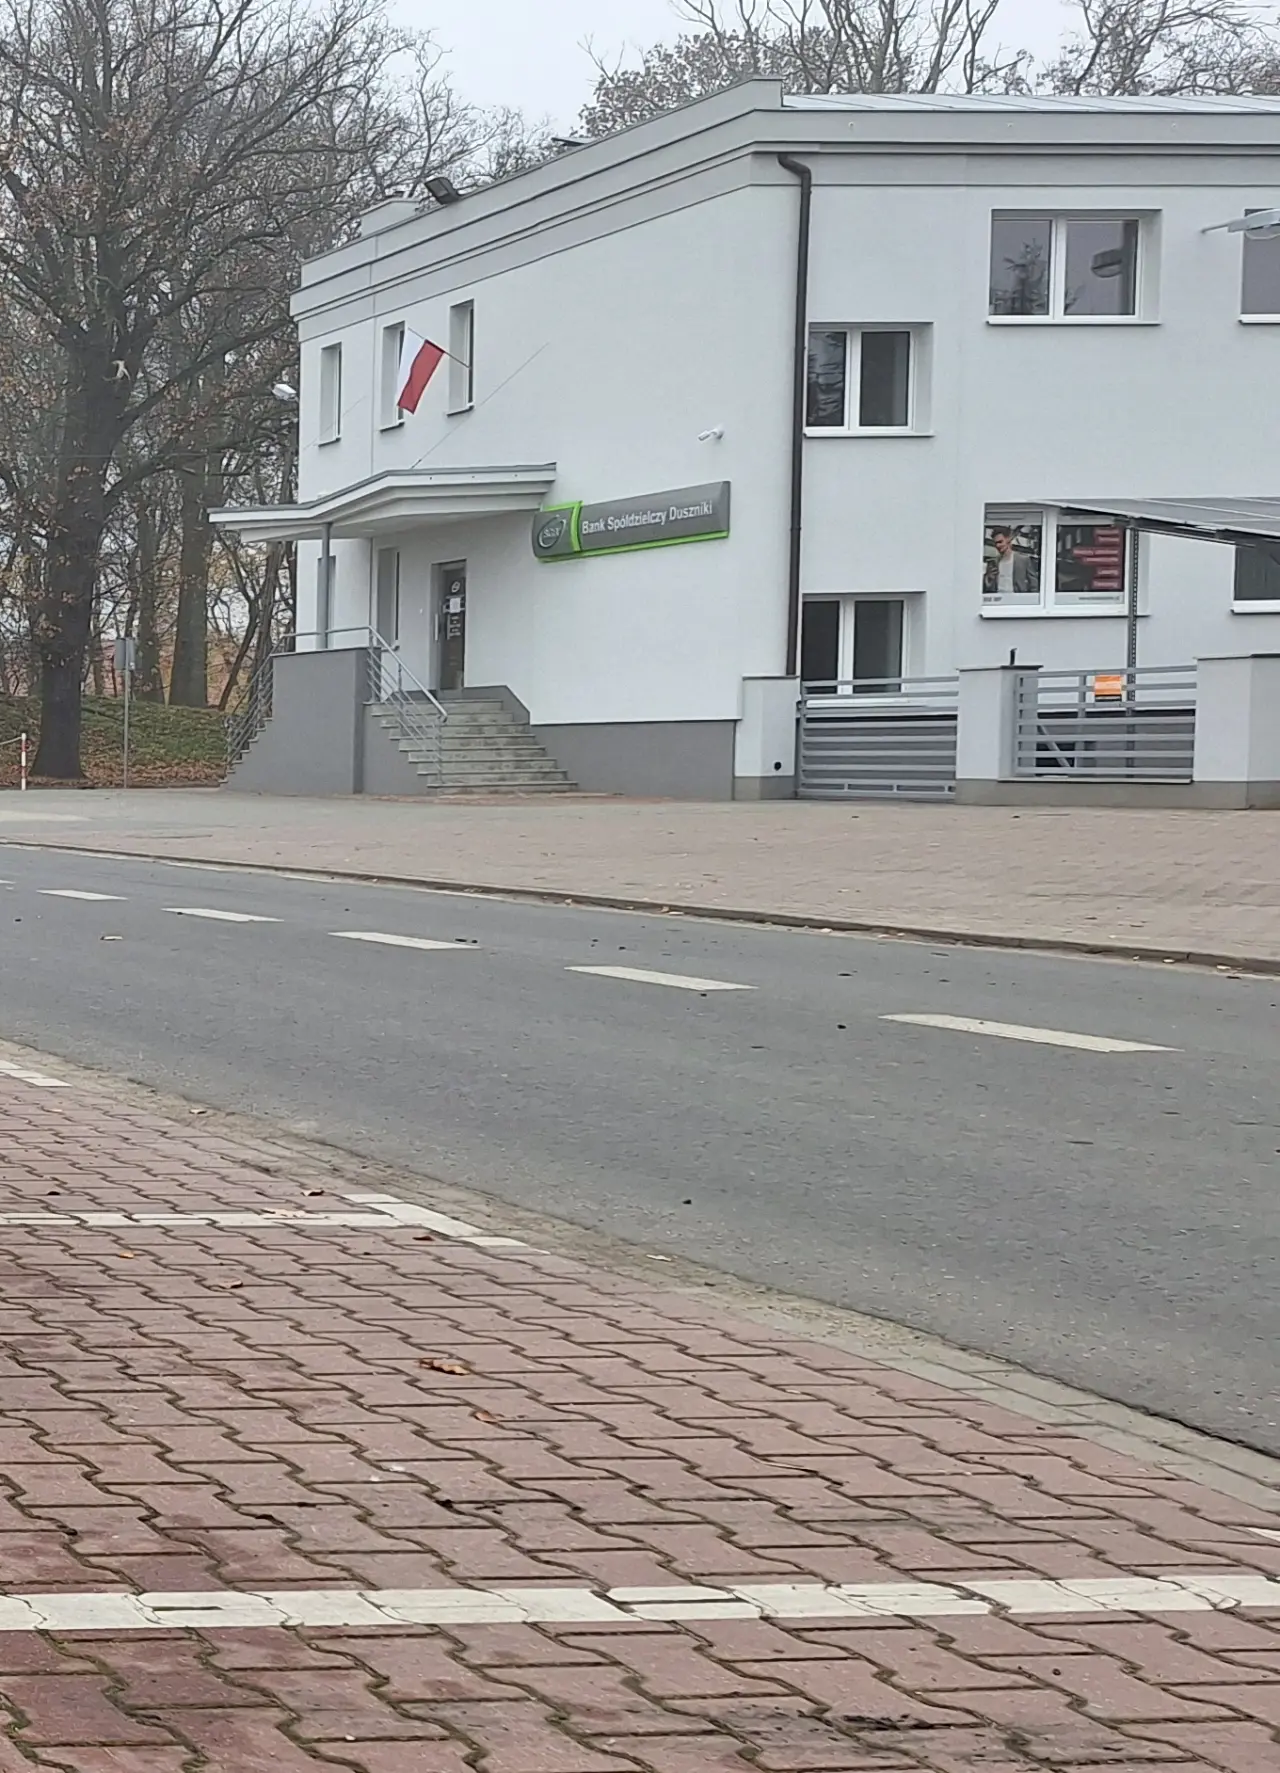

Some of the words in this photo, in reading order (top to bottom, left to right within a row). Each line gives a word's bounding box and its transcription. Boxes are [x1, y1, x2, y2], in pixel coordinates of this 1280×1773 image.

[581, 520, 605, 535] Bank
[607, 510, 668, 532] Spółdzielczy
[669, 500, 713, 521] Duszniki
